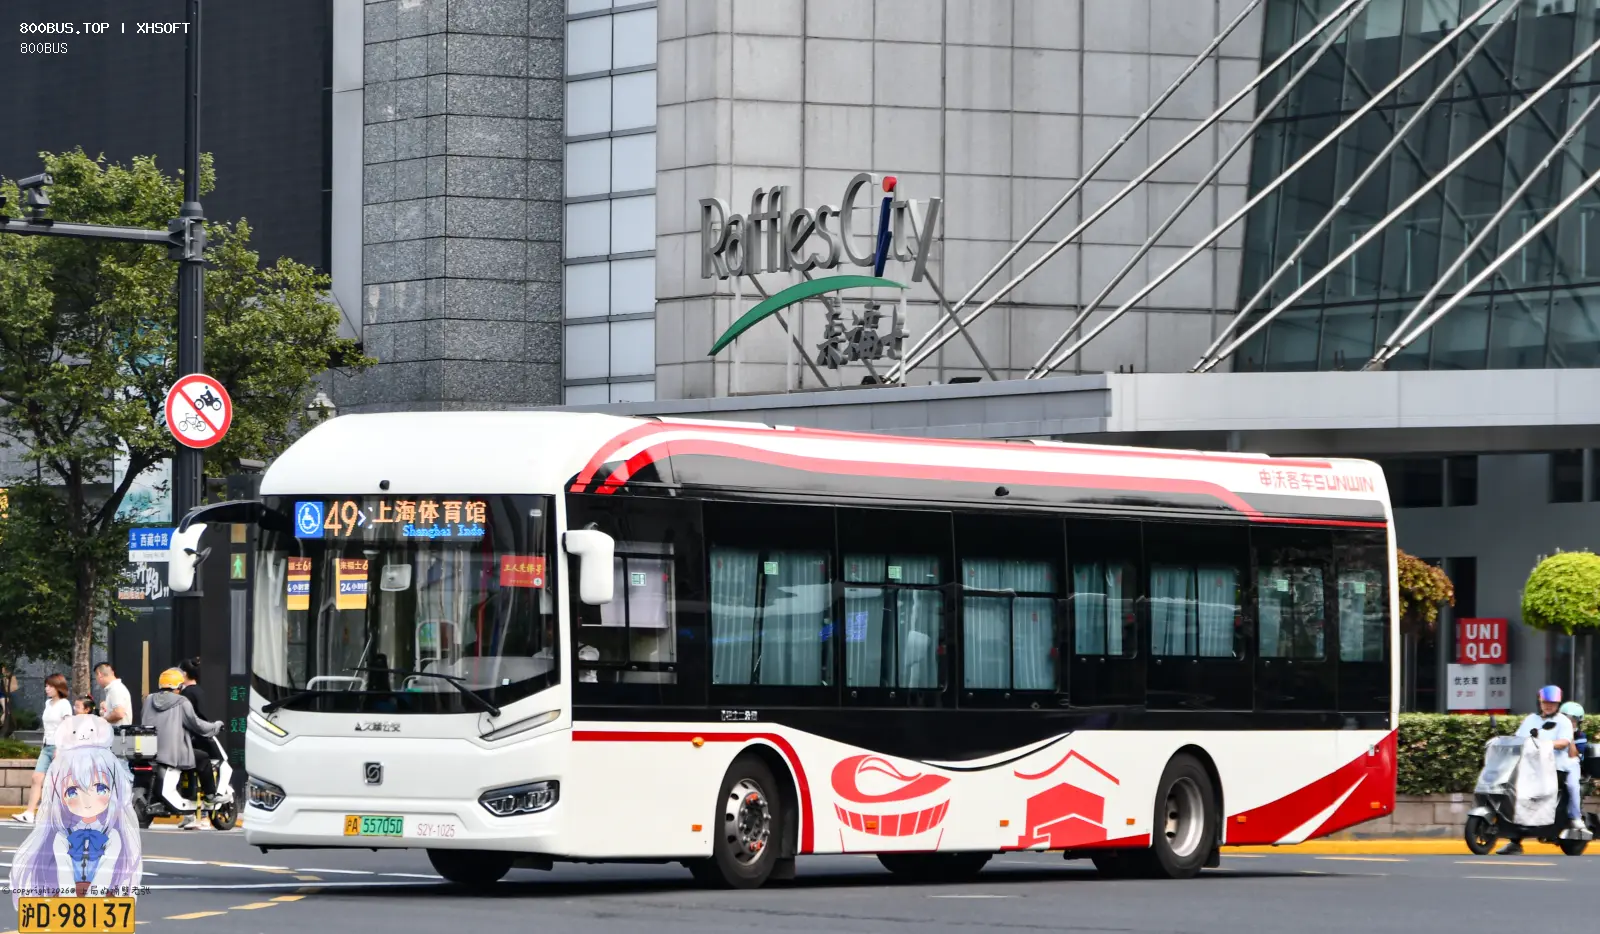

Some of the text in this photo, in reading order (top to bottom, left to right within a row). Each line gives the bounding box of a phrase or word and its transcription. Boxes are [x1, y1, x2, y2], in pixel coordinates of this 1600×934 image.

[1259, 469, 1374, 492] 申沃客车 SUNWIN
[324, 501, 358, 536] 49
[372, 500, 486, 524] 上海体育馆
[140, 532, 168, 547] 西藏中路
[402, 524, 451, 538] Shanghai
[1466, 623, 1499, 640] UNI
[1466, 642, 1502, 661] QLO
